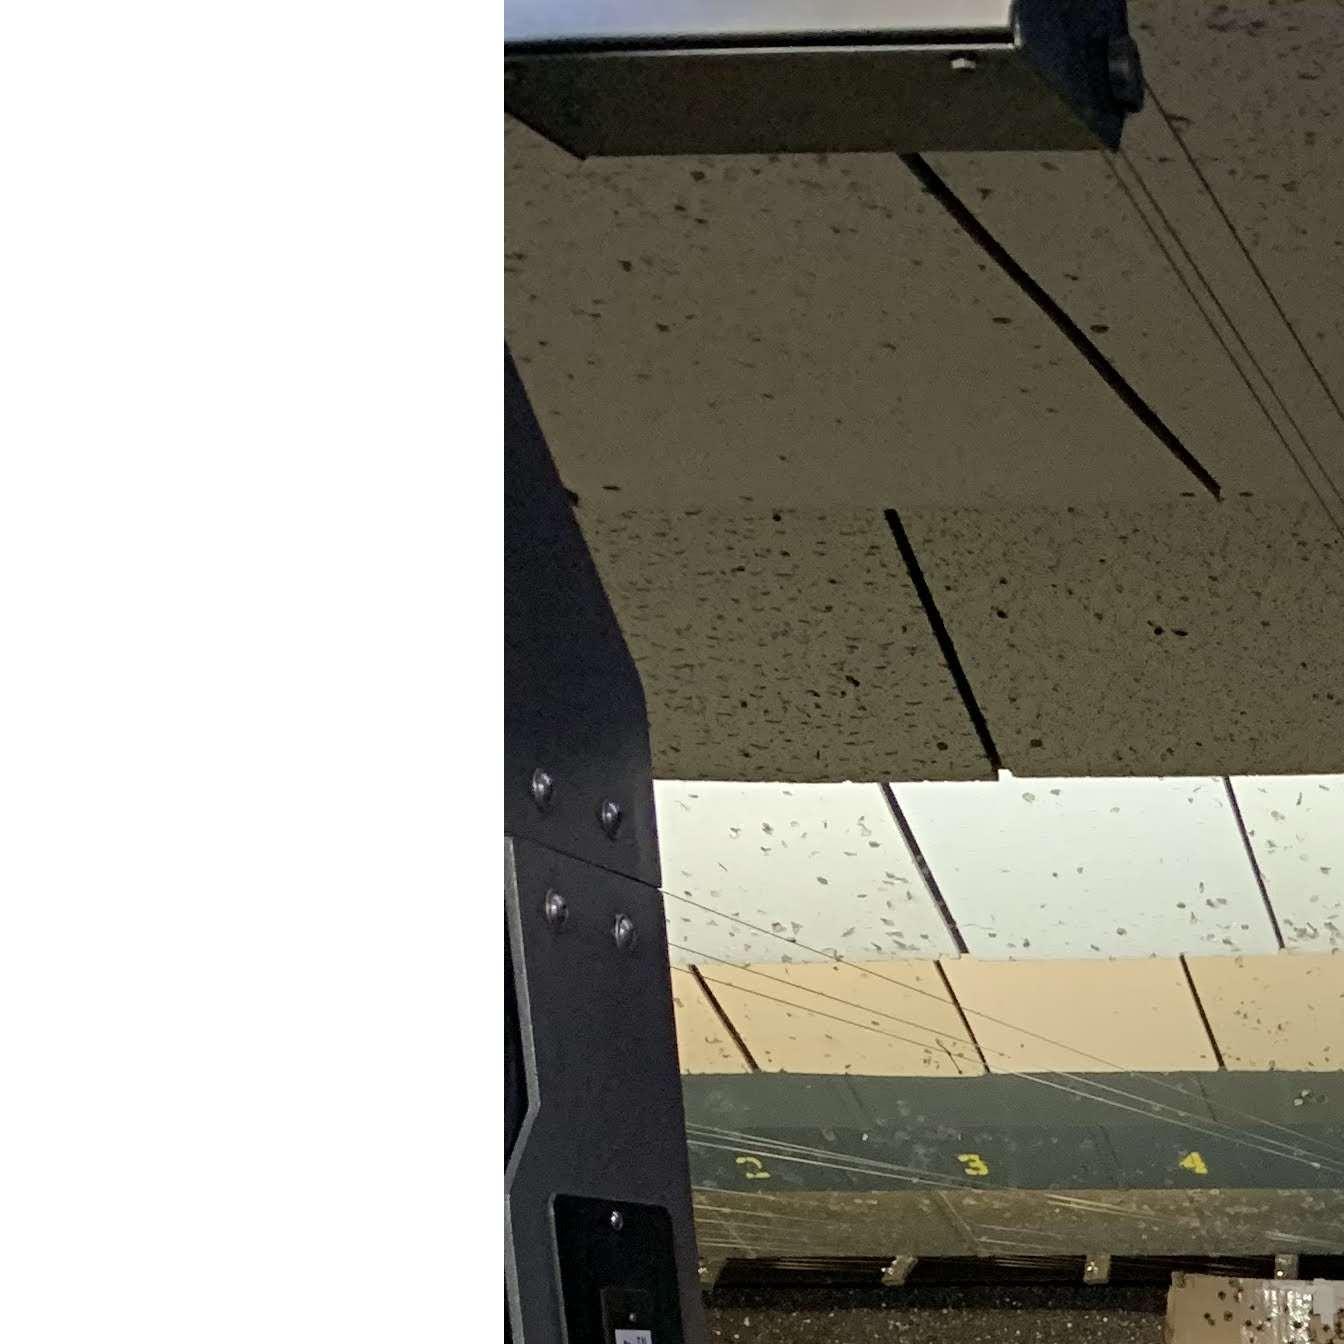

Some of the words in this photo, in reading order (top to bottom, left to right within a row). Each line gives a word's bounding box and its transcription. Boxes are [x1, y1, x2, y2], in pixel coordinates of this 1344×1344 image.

[735, 1156, 771, 1179] 2
[958, 1153, 989, 1176] 3
[1178, 1151, 1208, 1174] 4
